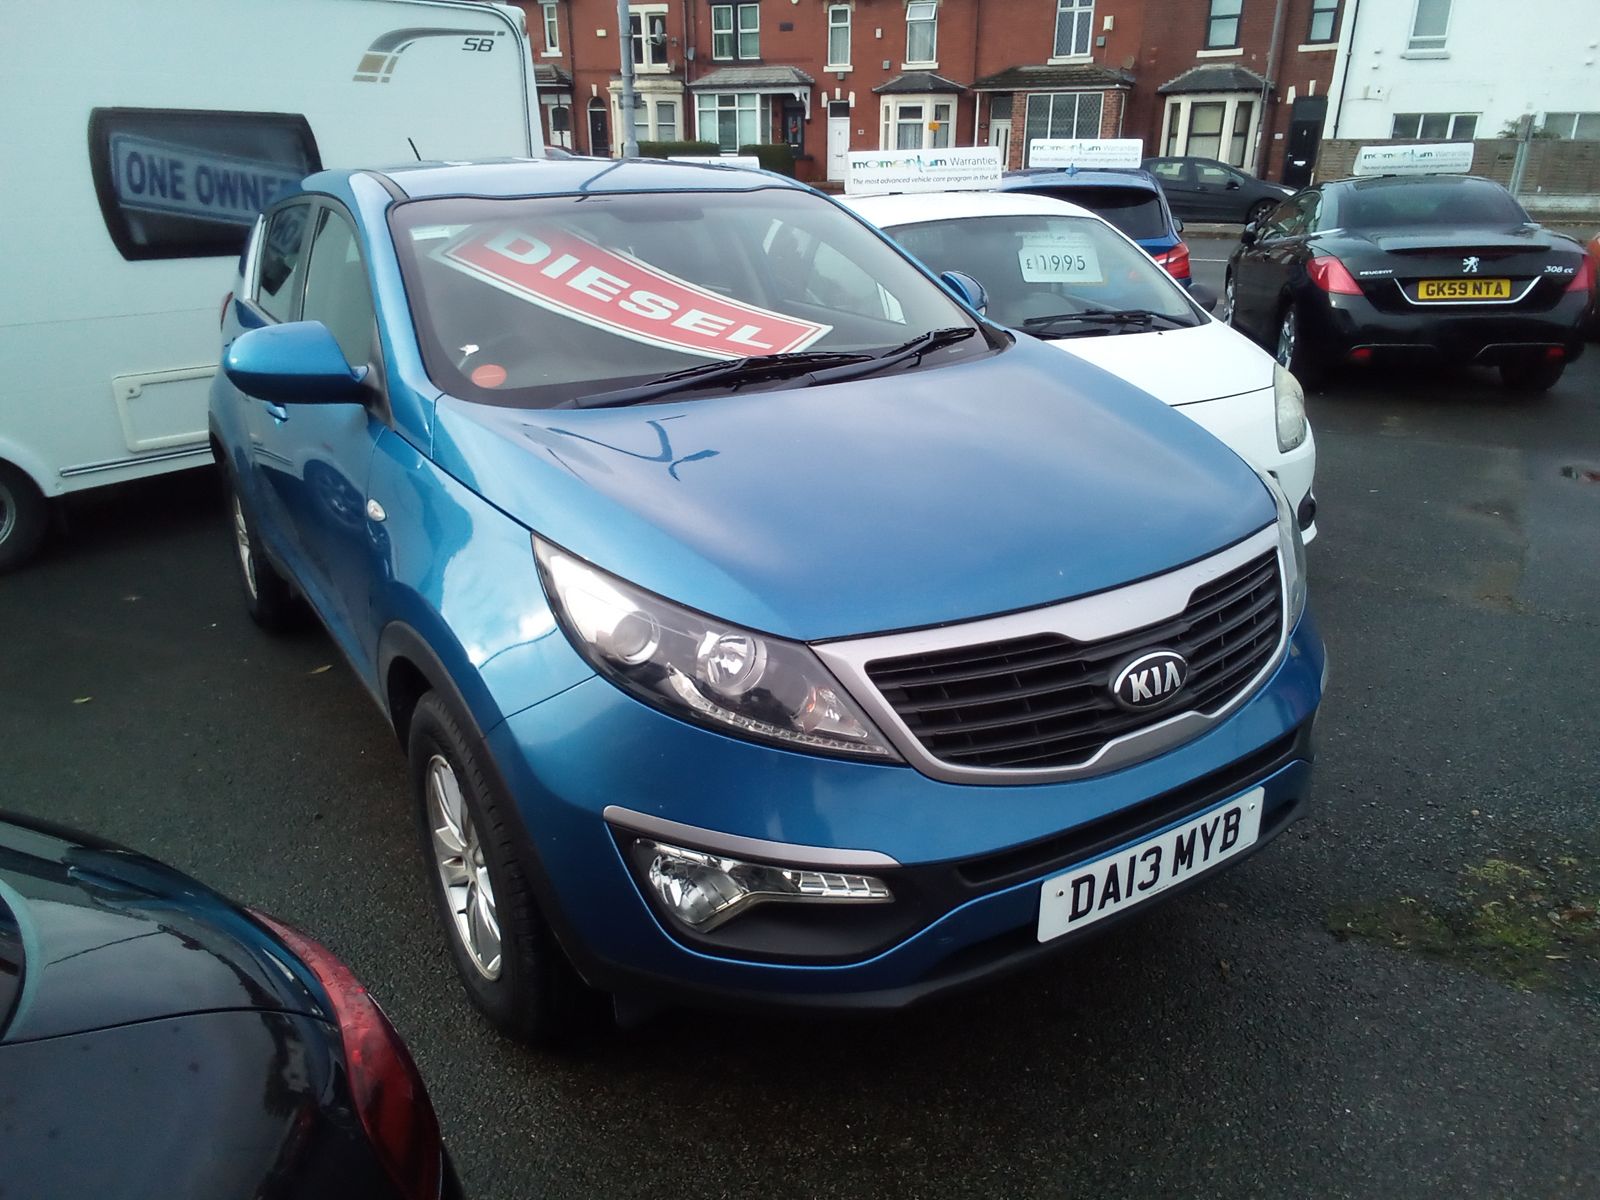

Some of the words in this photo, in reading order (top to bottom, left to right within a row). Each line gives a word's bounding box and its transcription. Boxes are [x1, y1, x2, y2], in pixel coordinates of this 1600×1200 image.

[461, 37, 494, 52] SB
[852, 155, 947, 172] momentum
[950, 156, 998, 166] Warranties
[126, 151, 187, 200] ONE
[853, 177, 863, 185] The
[880, 175, 910, 184] advanced
[911, 175, 932, 183] vehicle
[946, 175, 973, 184] program
[1544, 265, 1563, 274] 308
[483, 229, 775, 350] DIESEL
[1425, 281, 1469, 297] GK59
[1472, 279, 1504, 295] NTA
[1129, 661, 1181, 703] KIA
[1068, 845, 1163, 922] DA13
[1171, 806, 1242, 877] MYB
